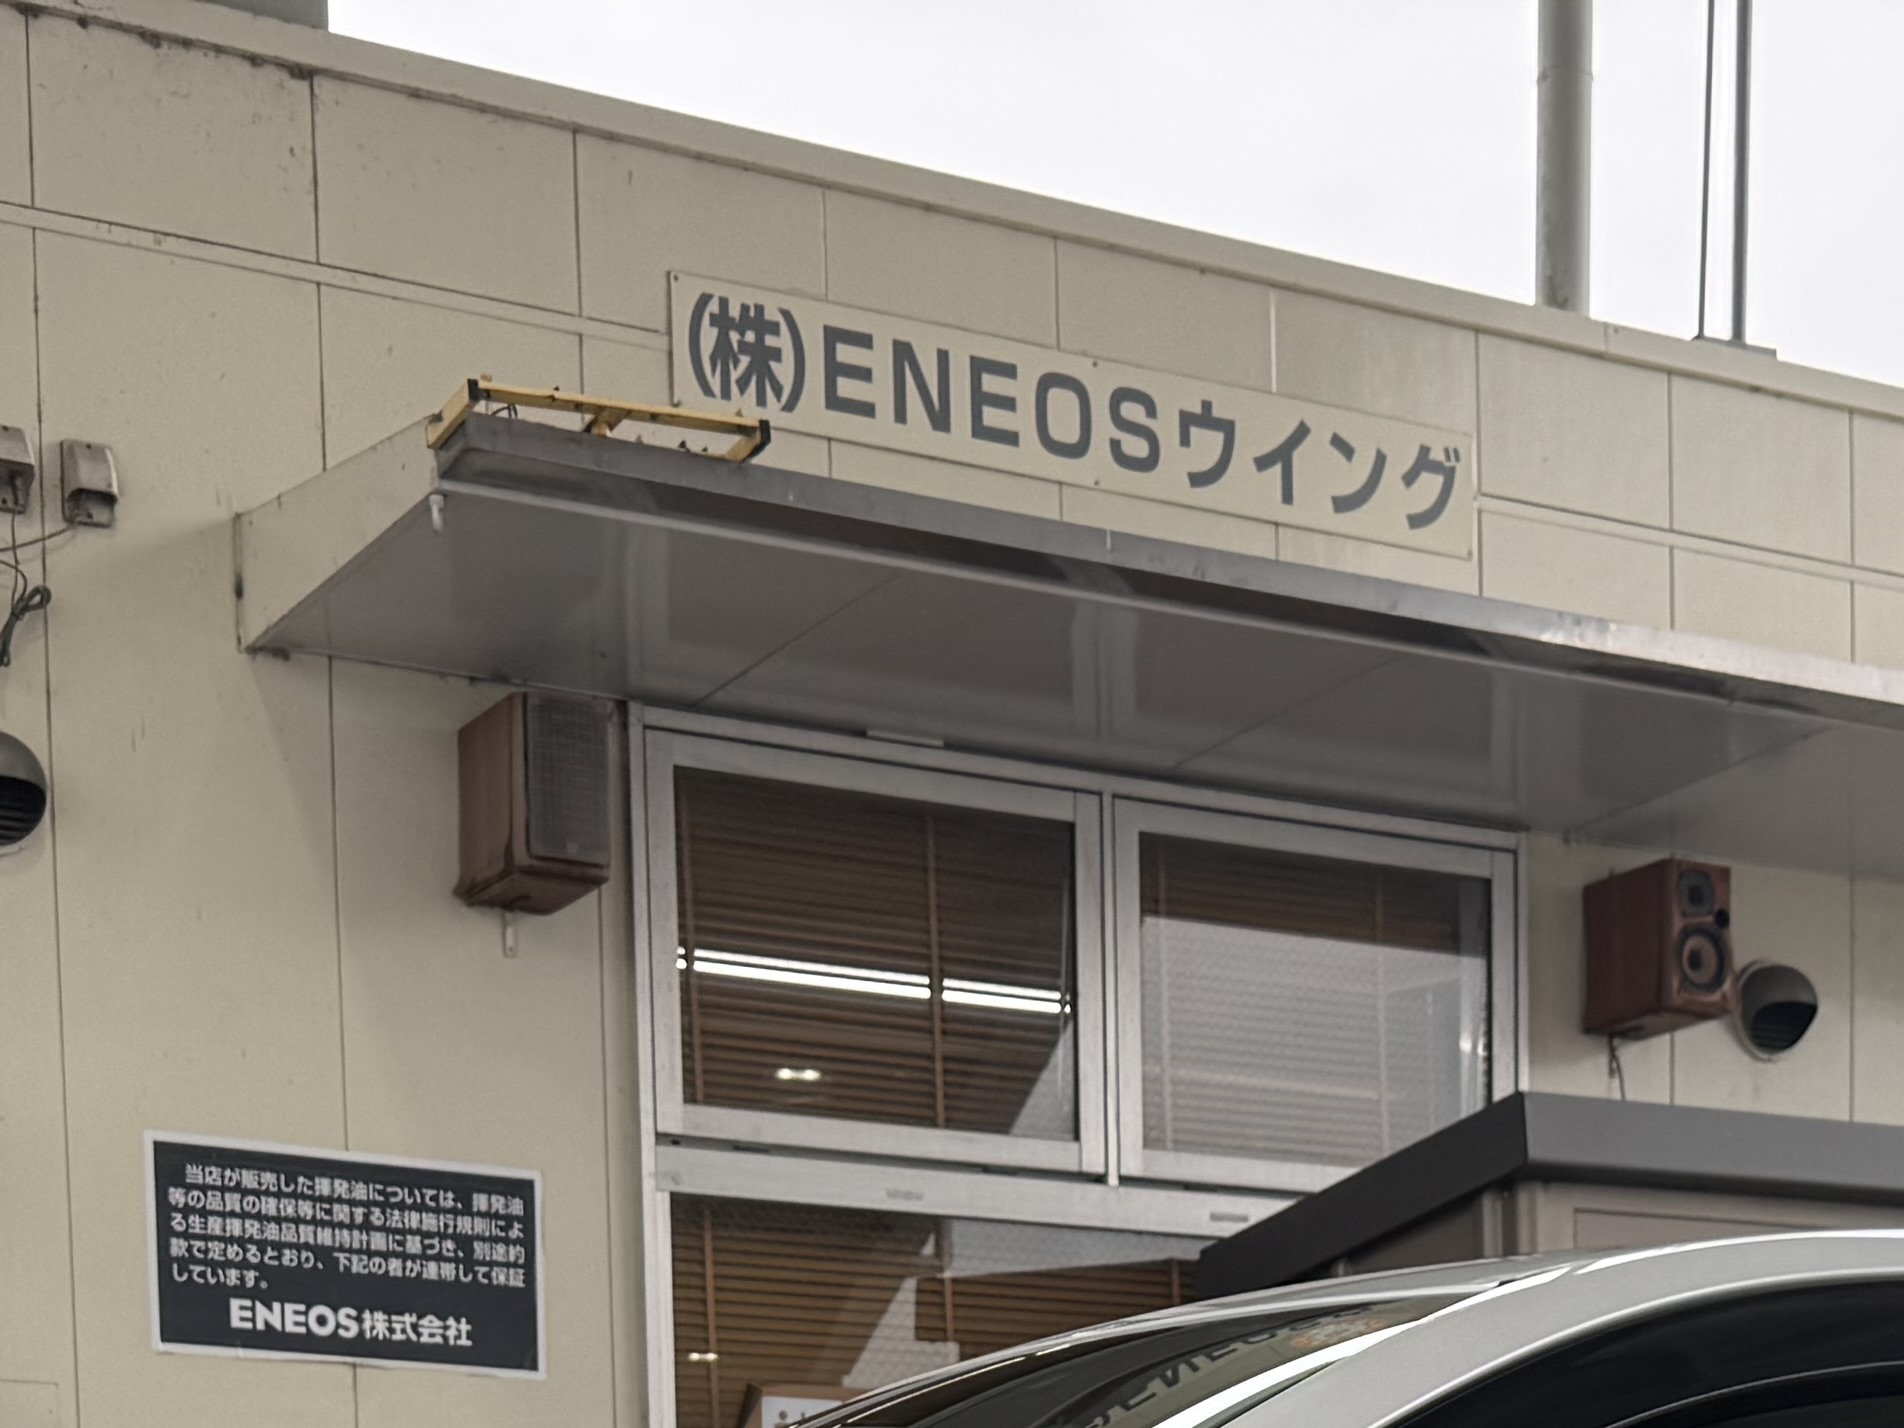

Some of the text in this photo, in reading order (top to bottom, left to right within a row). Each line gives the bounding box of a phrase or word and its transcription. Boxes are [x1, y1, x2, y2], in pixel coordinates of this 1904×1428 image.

[688, 291, 1463, 531] (株)ENEOSウイング
[171, 1262, 268, 1290] しています。
[229, 1297, 473, 1348] ENEOS株式会社
